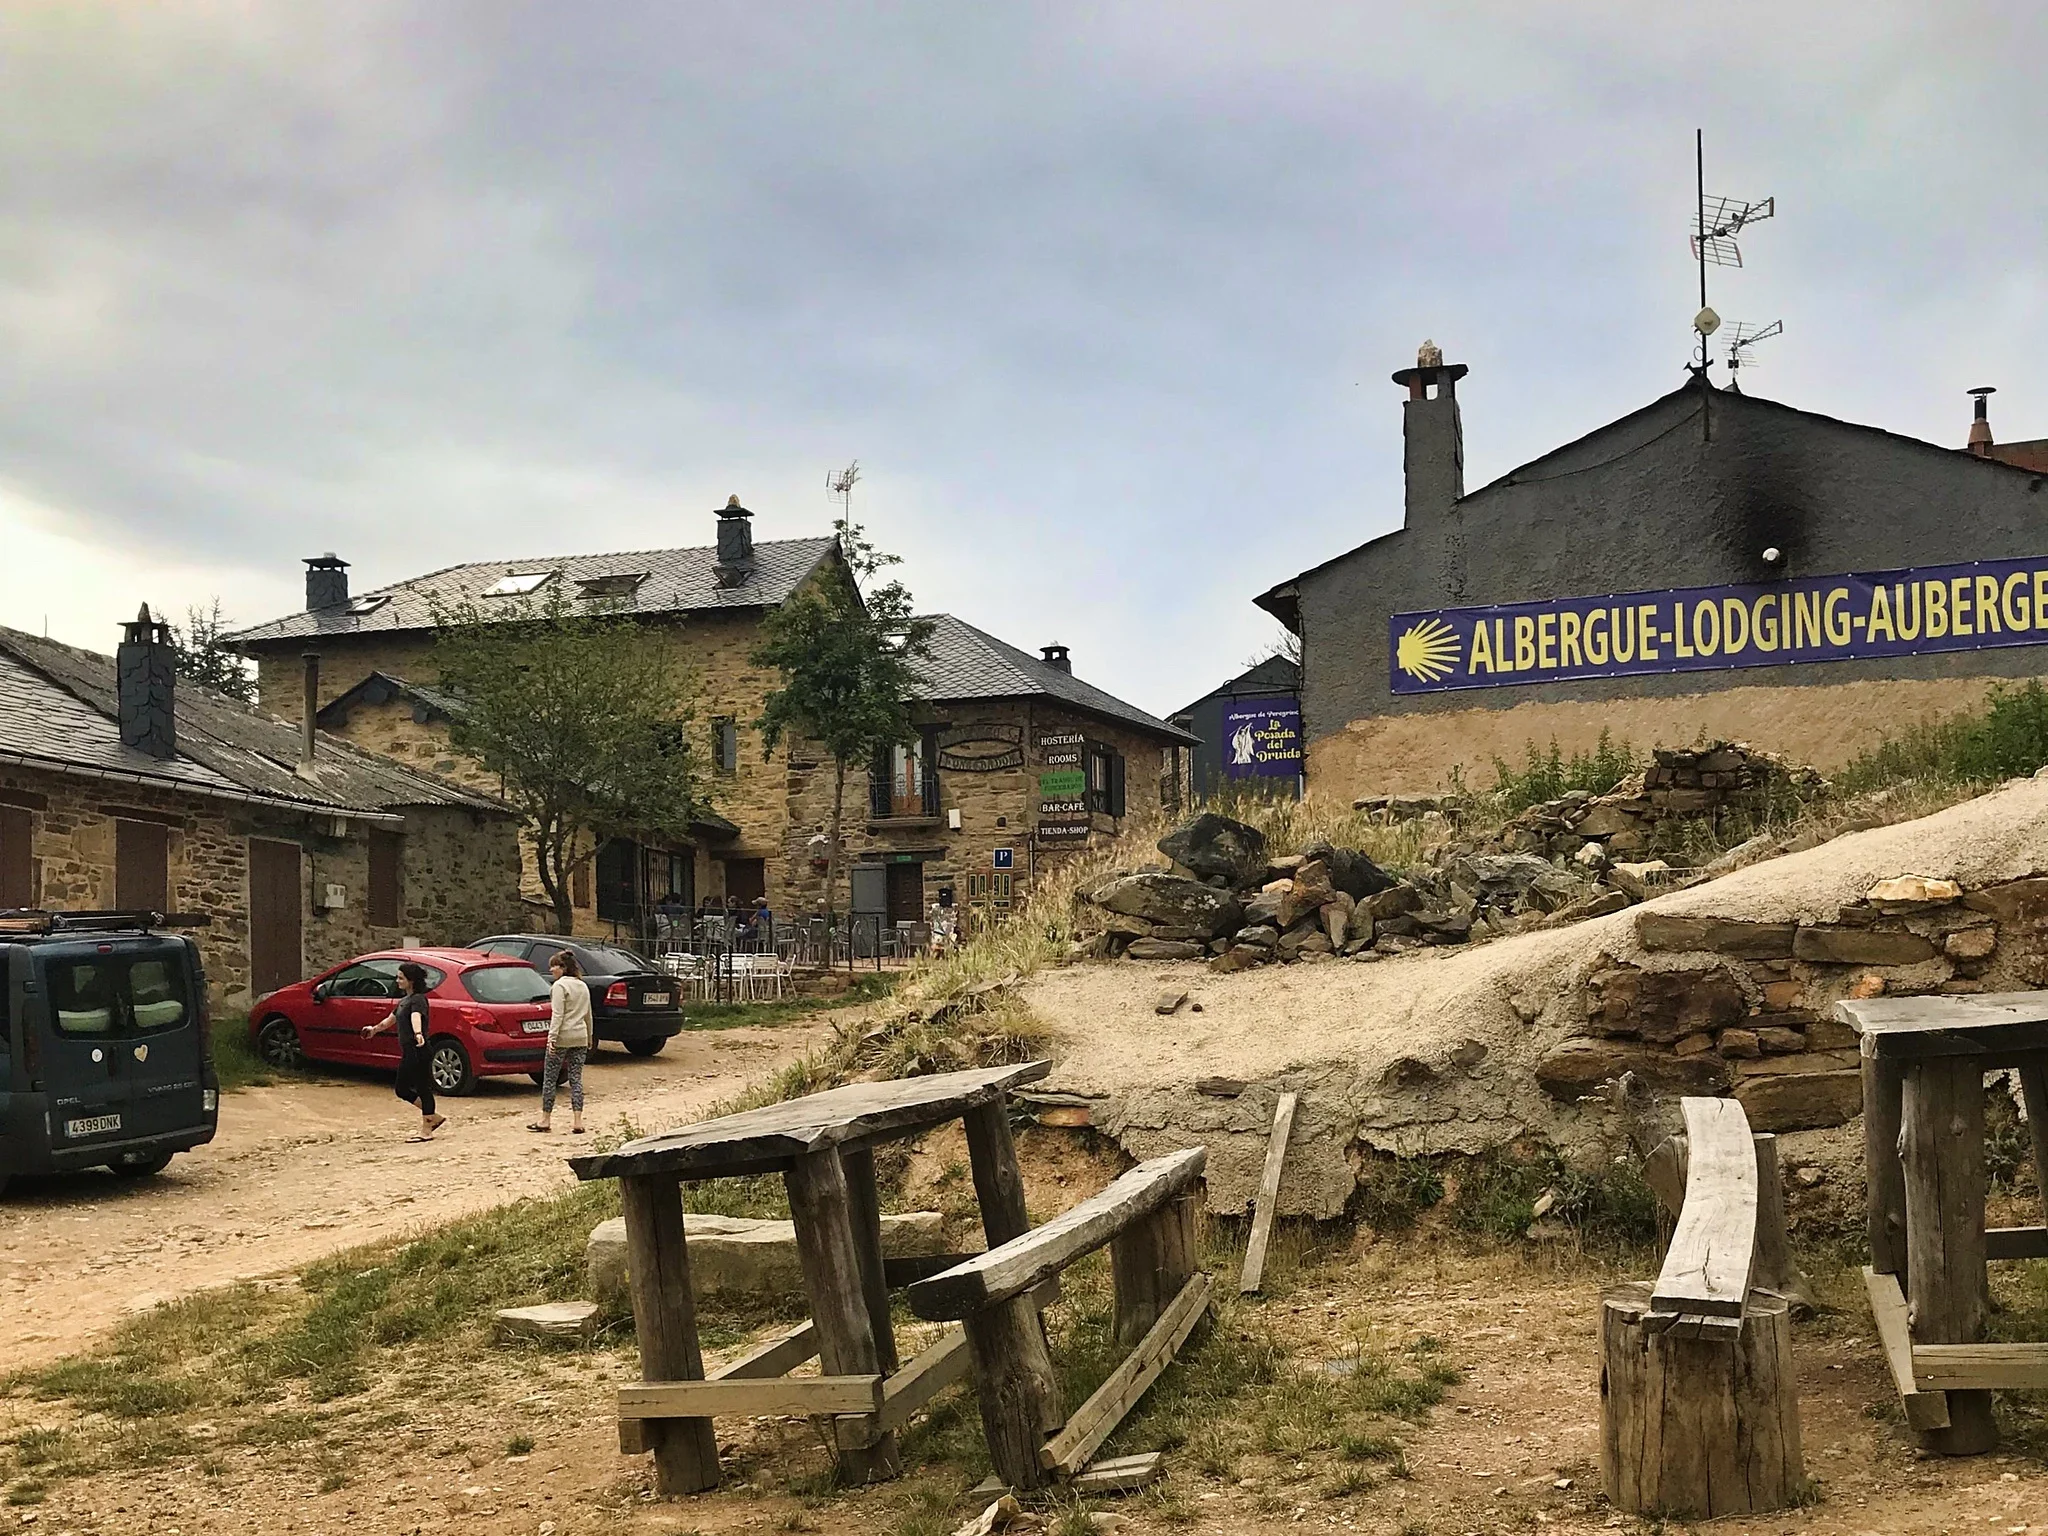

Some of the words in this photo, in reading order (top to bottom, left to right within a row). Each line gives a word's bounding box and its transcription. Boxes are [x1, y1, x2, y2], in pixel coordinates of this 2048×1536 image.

[1268, 719, 1281, 730] La
[1254, 728, 1296, 742] Posada
[1267, 740, 1283, 749] del
[1048, 753, 1078, 764] ROOMS
[1256, 748, 1301, 763] Druida
[1040, 826, 1089, 835] TIENDA-SHOP
[999, 851, 1008, 861] P
[56, 1097, 81, 1106] OPEL
[72, 1120, 100, 1134] 4399
[100, 1116, 120, 1129] DNK
